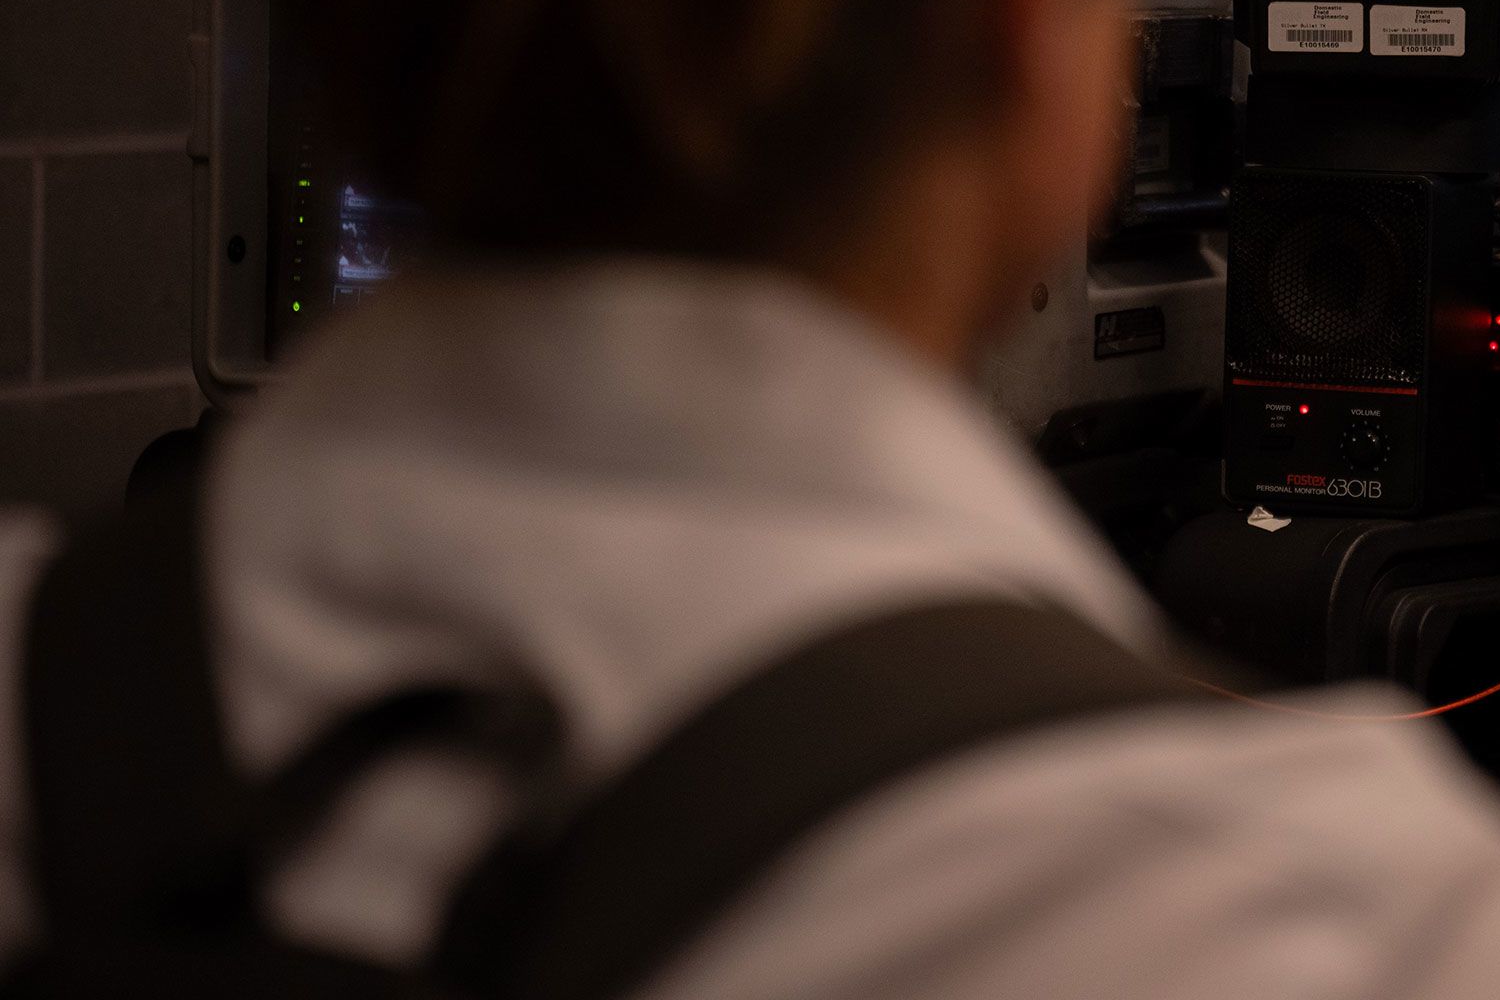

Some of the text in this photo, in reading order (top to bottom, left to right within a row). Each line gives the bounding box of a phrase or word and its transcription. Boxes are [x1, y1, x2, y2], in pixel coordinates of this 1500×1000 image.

[1265, 403, 1292, 412] POWER
[1350, 408, 1382, 417] VOLUME
[1286, 474, 1327, 487] Fostex
[1256, 478, 1382, 498] PERSONAL MONITOR 6301B
